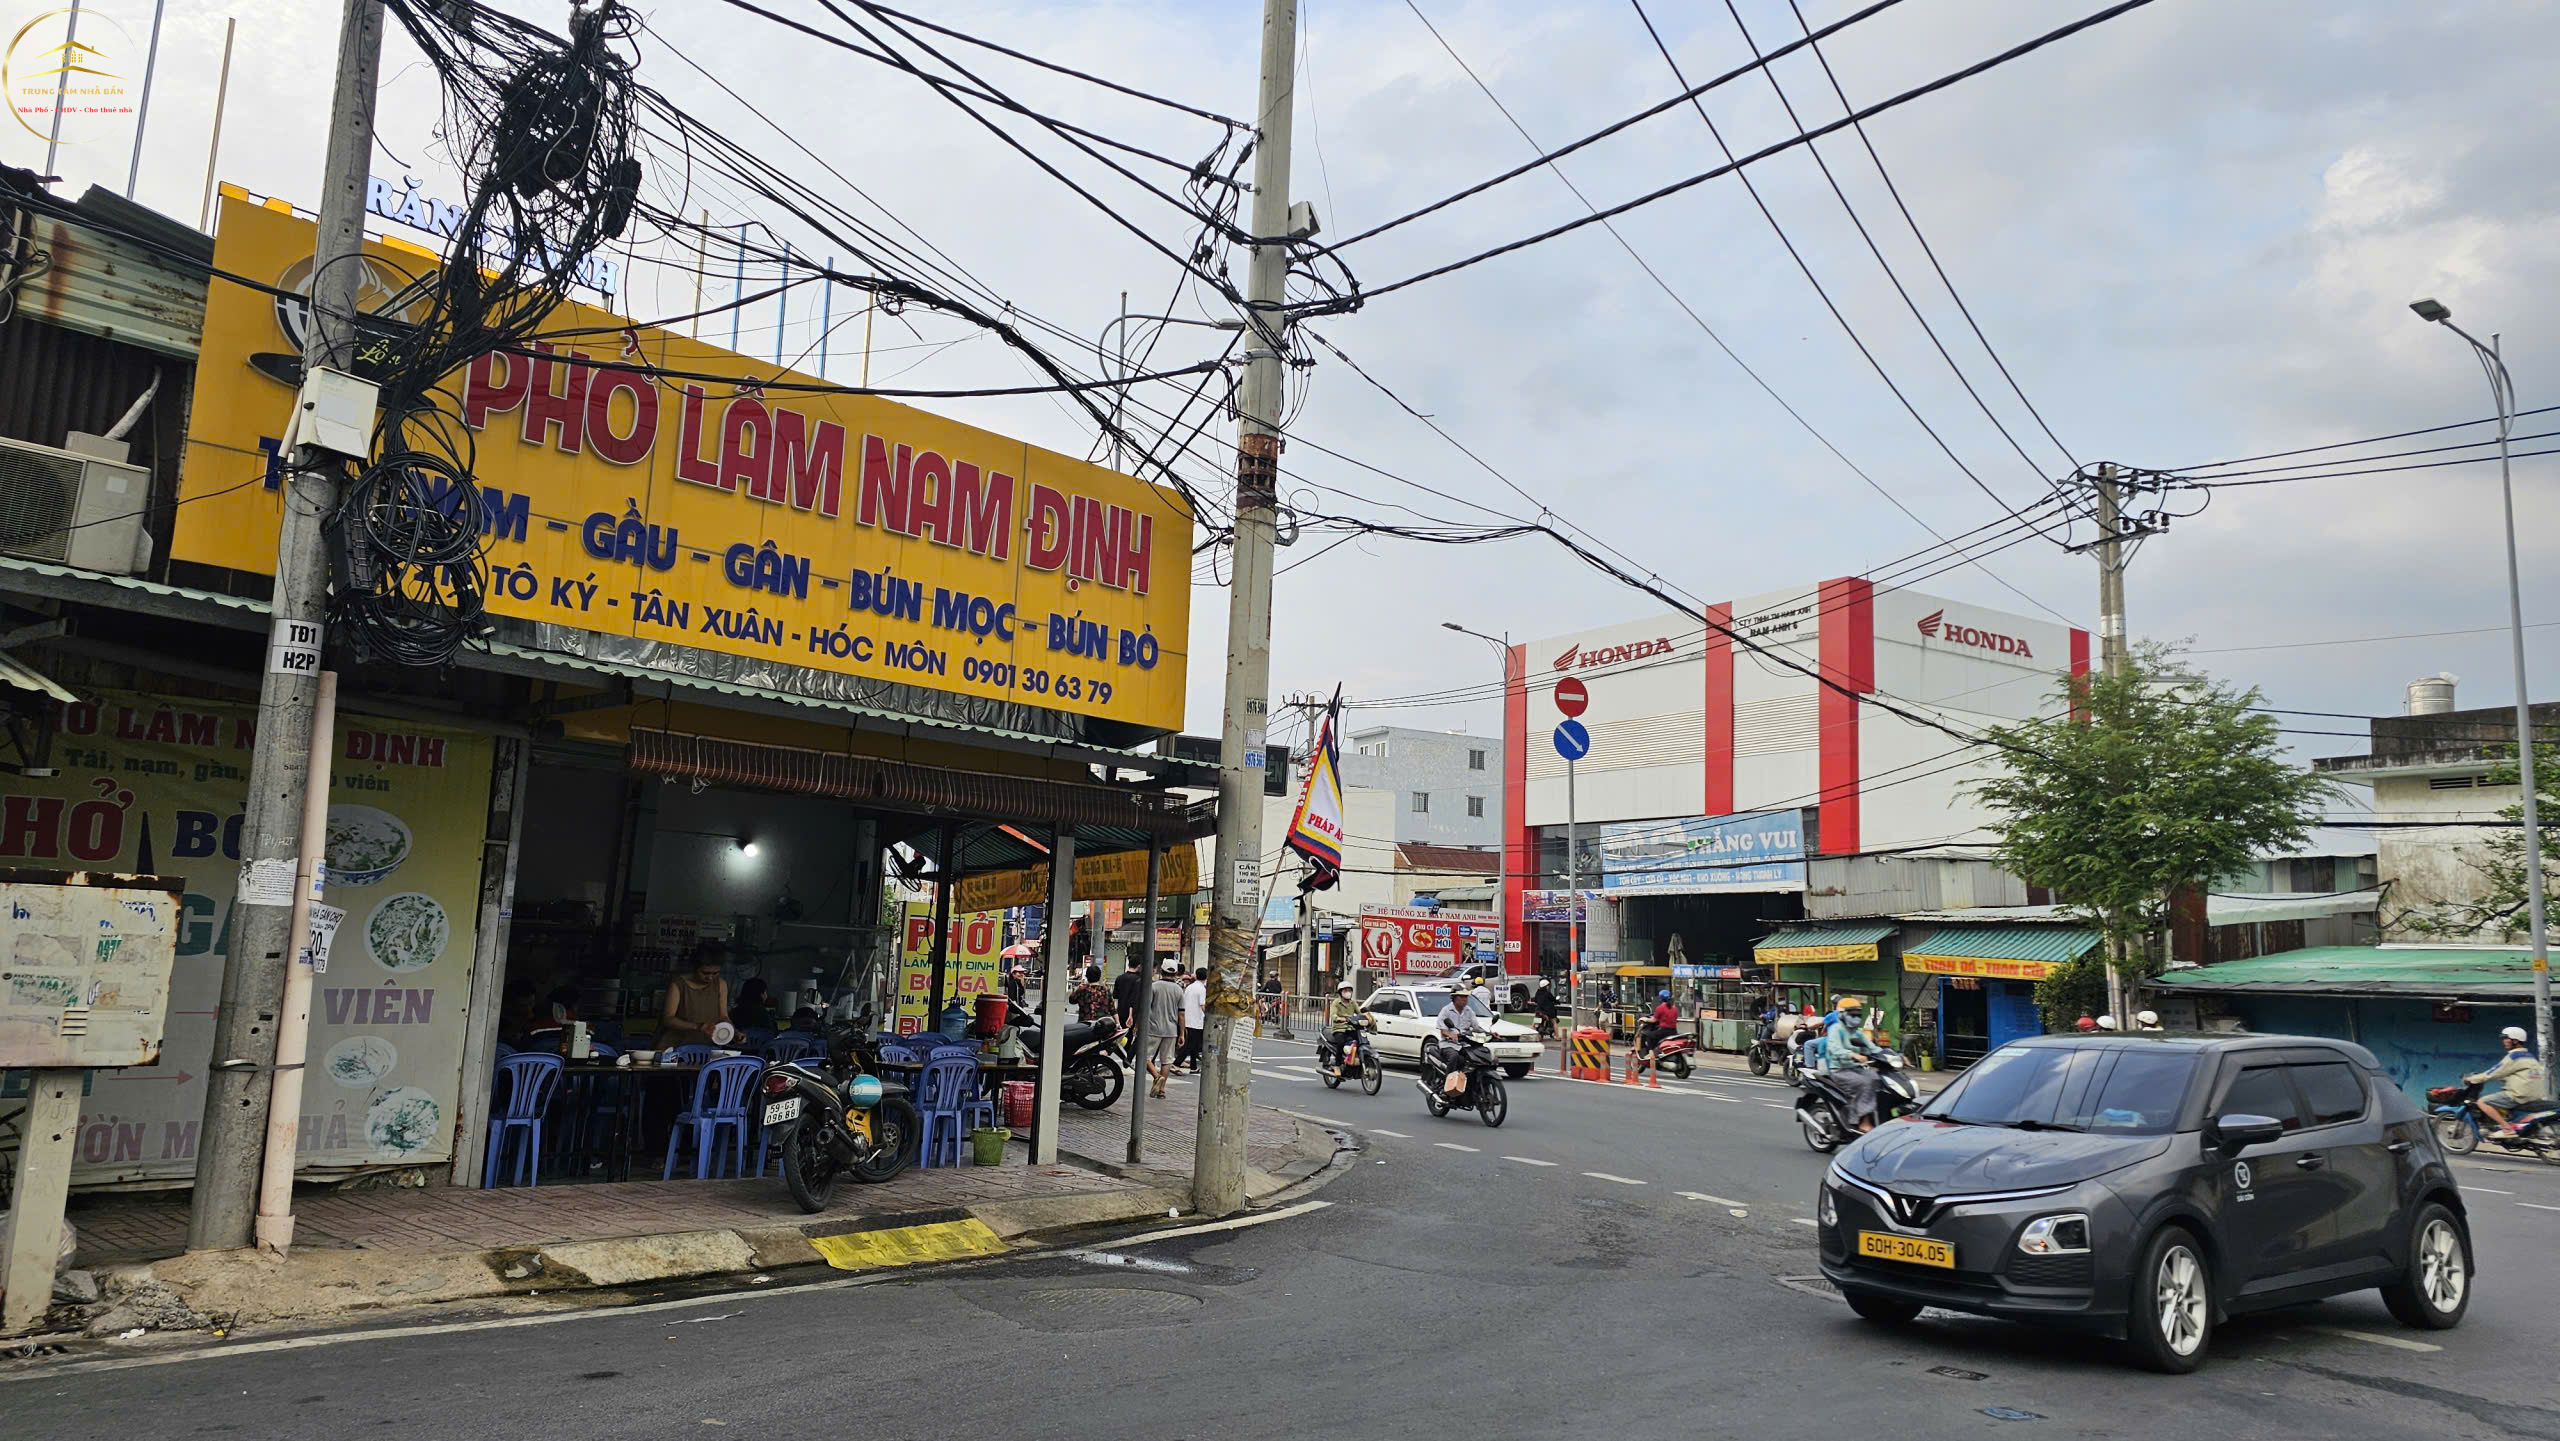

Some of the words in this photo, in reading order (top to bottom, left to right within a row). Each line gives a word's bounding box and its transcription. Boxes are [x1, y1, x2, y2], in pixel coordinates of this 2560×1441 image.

[462, 327, 660, 466] PHỞ
[675, 374, 847, 518] LÂM
[856, 433, 1016, 562] NAM
[1024, 483, 1153, 595] ĐỊNH
[582, 497, 678, 572] GẦU
[723, 539, 810, 600] GÂN
[849, 566, 923, 622] BÚN
[932, 587, 1017, 646] MỌC
[1047, 610, 1109, 661] BÚN
[1118, 624, 1159, 670] BÒ
[290, 625, 316, 645] TĐ1
[492, 562, 538, 600] TÔ
[551, 572, 598, 611] KÝ
[630, 588, 690, 630] TÂN
[700, 607, 784, 646] XUÂN
[808, 622, 874, 662] HÓC
[884, 640, 947, 676] MÔN
[962, 656, 1017, 688] 0901
[1022, 667, 1050, 695] 30
[1055, 674, 1082, 700] 63
[1087, 680, 1113, 705] 79
[1944, 623, 2033, 658] HONDA
[283, 651, 316, 671] H2P
[1579, 637, 1674, 668] HONDA
[115, 703, 220, 748] LÂM
[346, 729, 447, 771] ĐỊNH
[124, 756, 185, 779] nạm,
[345, 773, 391, 793] viên
[1308, 813, 1334, 834] PHÁP
[1760, 830, 1796, 849] VUI
[1378, 907, 1388, 916] HỆ
[1391, 907, 1415, 917] THỐNG
[1446, 912, 1460, 920] NAM
[1376, 931, 1393, 955] 0
[966, 960, 995, 973] ĐỊNH
[1924, 959, 1956, 972] THAN
[1985, 962, 2019, 975] THAN
[957, 972, 989, 992] GÀ
[323, 979, 435, 1025] VIÊN
[299, 1098, 349, 1151] HẢ
[1866, 1237, 1946, 1263] 60H-304.05
